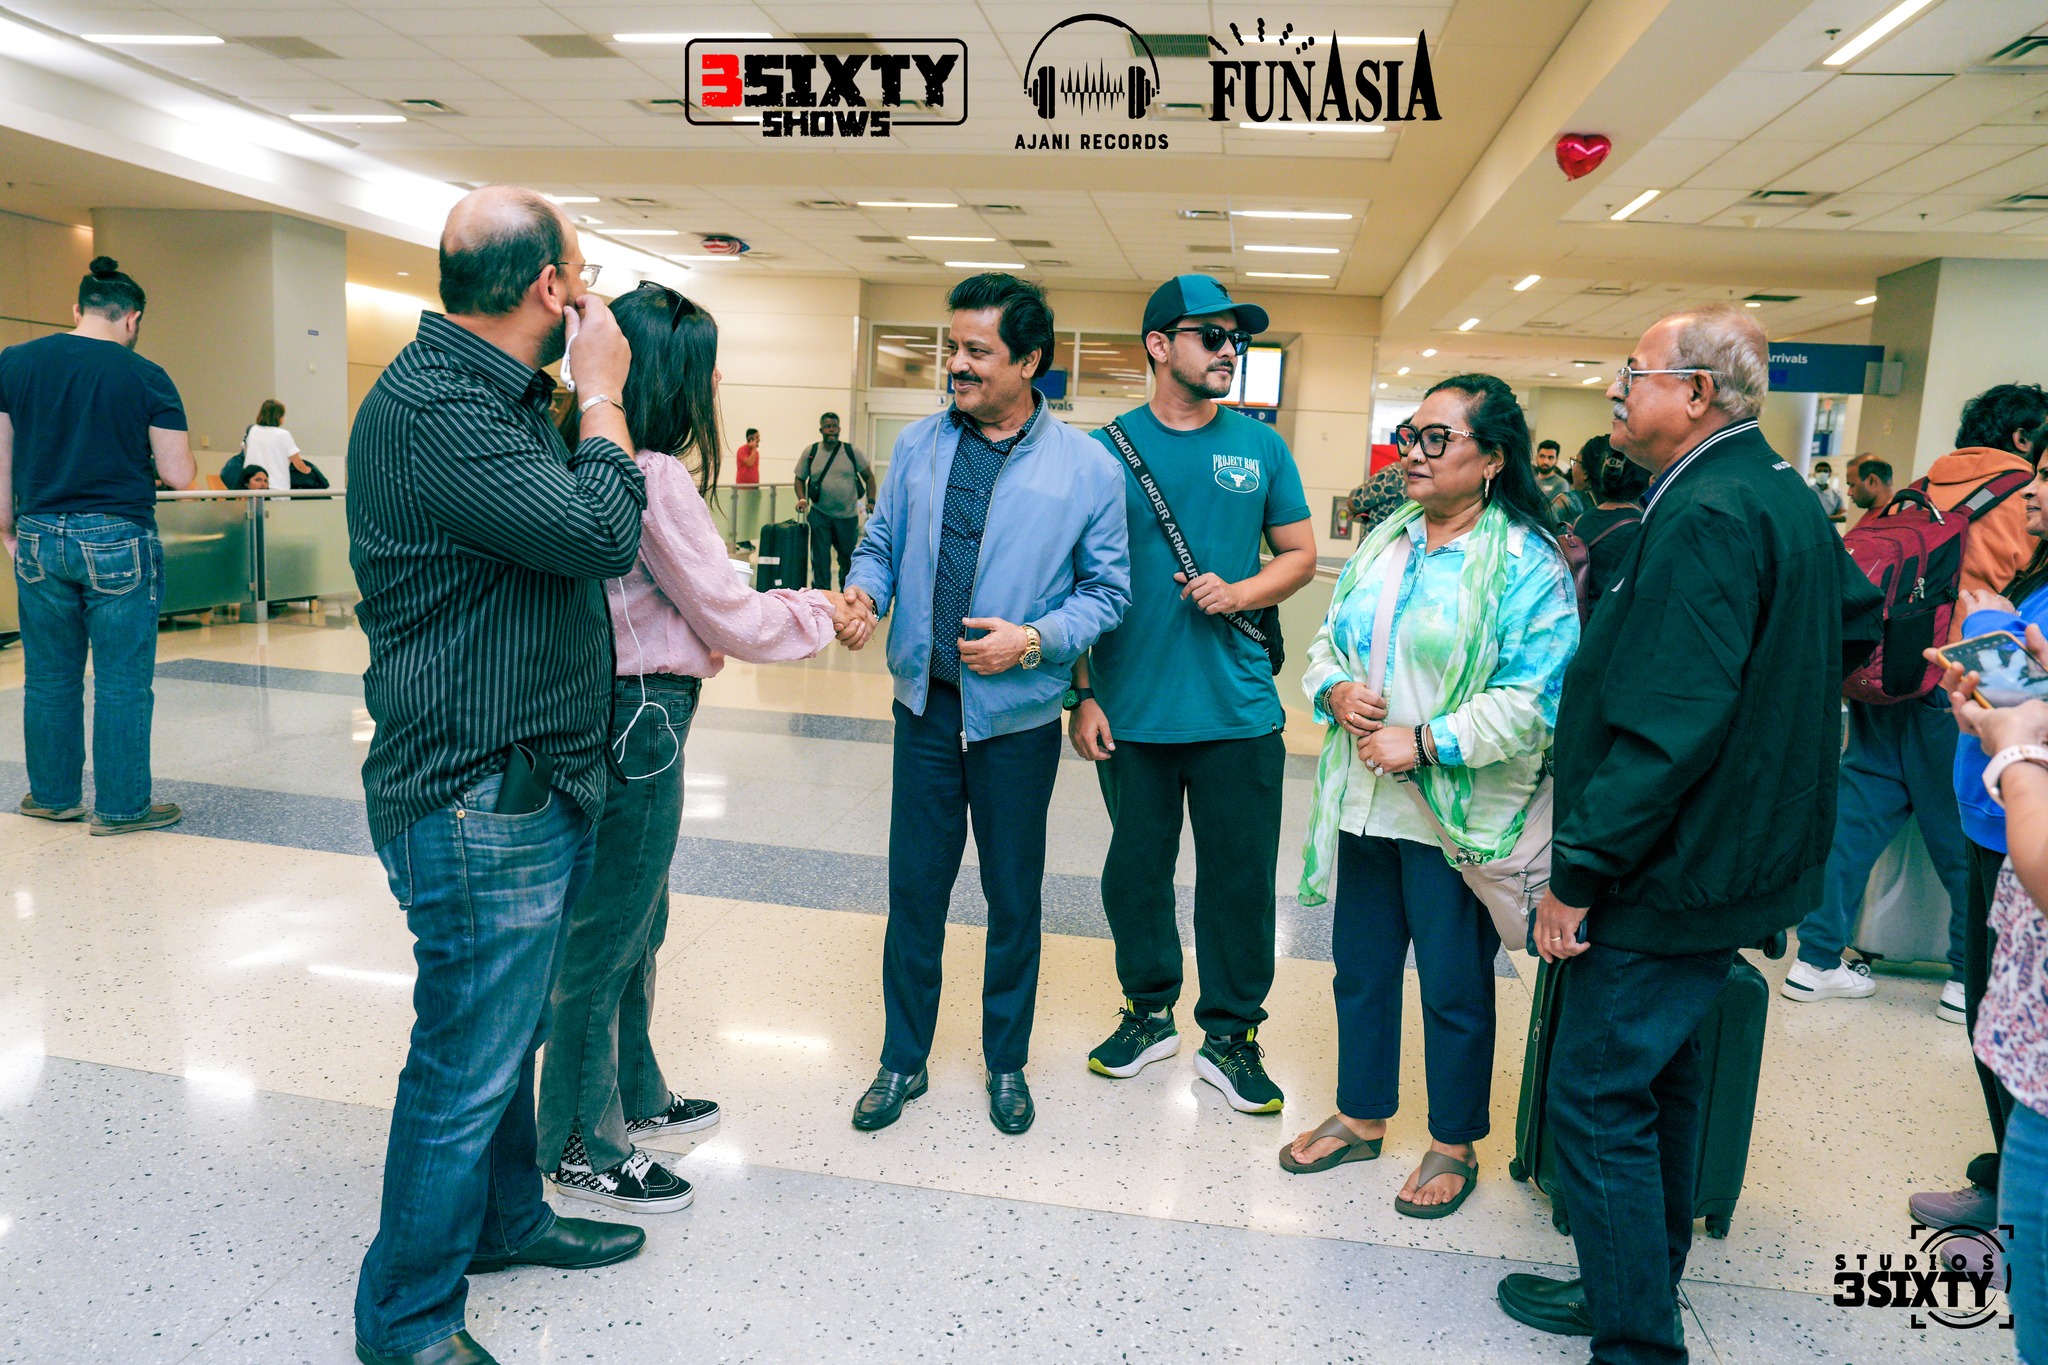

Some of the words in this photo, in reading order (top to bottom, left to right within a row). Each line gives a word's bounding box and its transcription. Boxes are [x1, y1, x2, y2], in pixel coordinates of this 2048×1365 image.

[1106, 425, 1142, 469] ARMOUR
[1140, 473, 1171, 521] UNDER
[1212, 454, 1243, 472] PROJECT
